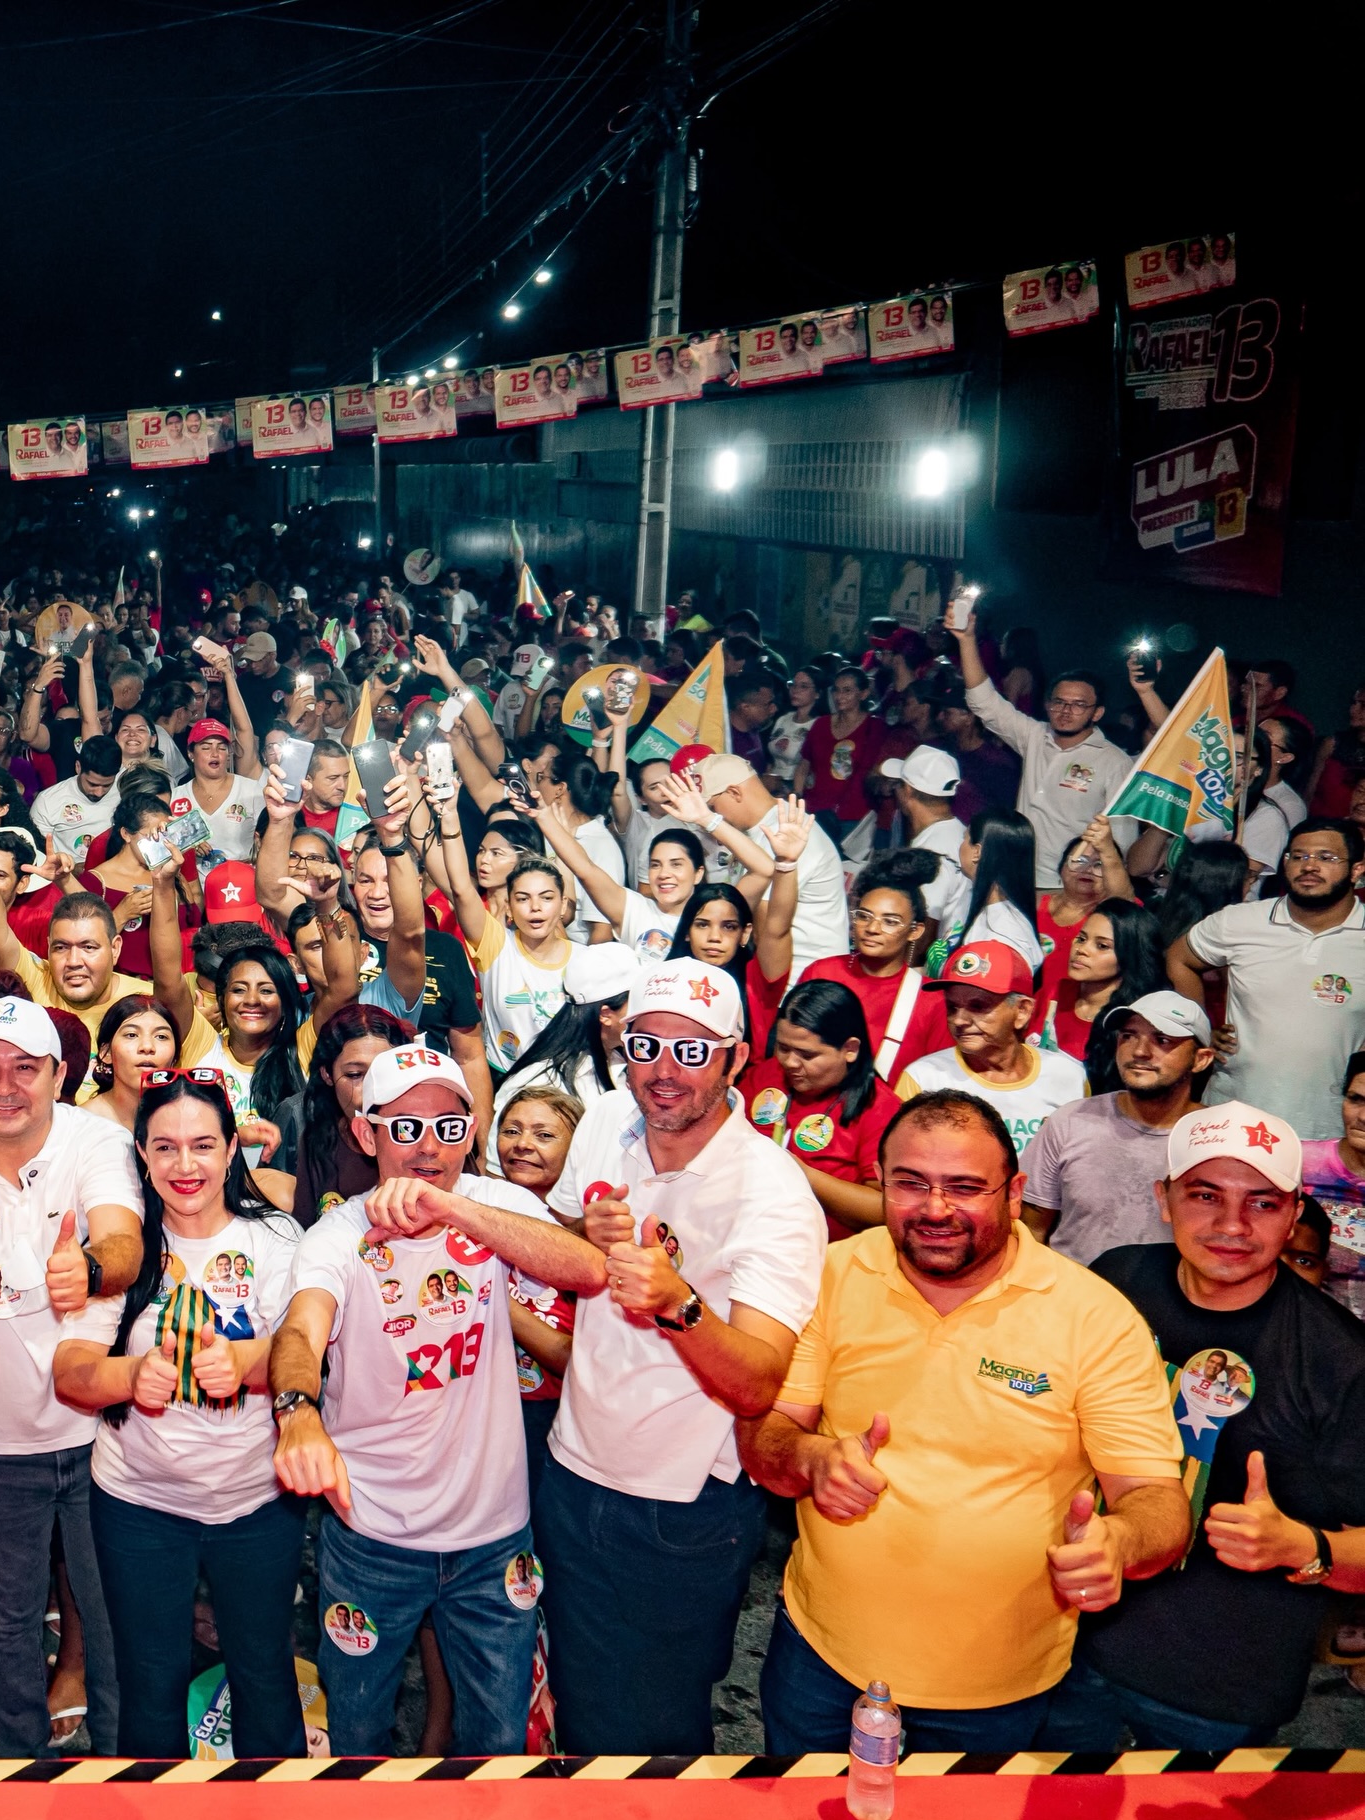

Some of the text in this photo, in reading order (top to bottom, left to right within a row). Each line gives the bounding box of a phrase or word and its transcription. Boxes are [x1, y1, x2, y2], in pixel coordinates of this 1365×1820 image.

[1139, 252, 1161, 274] 13
[1020, 279, 1041, 300] 13
[1133, 273, 1171, 290] RAFAEL
[883, 306, 904, 327] 13
[1014, 301, 1048, 316] RAFAEL
[1151, 316, 1212, 333] GOVERNADOR
[755, 331, 775, 351] 13
[876, 329, 912, 342] RAFAEL
[1126, 323, 1217, 376] RAFAEL
[1212, 298, 1281, 402] 13
[631, 353, 652, 373] 13
[747, 352, 784, 367] RAFAEL
[510, 372, 530, 392] 13
[625, 376, 661, 389] RAFAEL
[347, 389, 363, 405] 13
[389, 390, 408, 409] 13
[503, 395, 539, 407] RAFAEL
[265, 405, 285, 424] 13
[340, 407, 371, 418] RAFAEL
[383, 411, 417, 423] RAFAEL
[141, 417, 161, 435] 13
[258, 426, 294, 438] RAFAEL
[21, 428, 41, 447] 13
[136, 438, 170, 450] RAFAEL
[16, 449, 50, 460] RAFAEL
[1135, 438, 1240, 505] LULA
[643, 736, 667, 756] Pela
[1138, 781, 1166, 798] Pela
[646, 973, 680, 988] Rafael
[698, 984, 714, 1000] 13
[1334, 994, 1345, 1004] 13
[634, 1038, 652, 1060] R
[678, 1043, 704, 1063] 13
[395, 1049, 441, 1070] R13
[152, 1071, 169, 1083] R
[192, 1069, 215, 1081] 13
[397, 1121, 415, 1141] R
[441, 1120, 464, 1141] 13
[1190, 1119, 1230, 1138] Rafael
[1254, 1129, 1273, 1146] 13
[211, 1284, 236, 1294] RAFAEL
[235, 1283, 250, 1298] 13
[428, 1305, 452, 1316] RAFAEL
[451, 1299, 467, 1315] 13
[404, 1322, 485, 1397] R13
[979, 1357, 1036, 1382] Magno
[1010, 1379, 1033, 1392] 1013
[1199, 1378, 1212, 1390] 13
[355, 1635, 370, 1649] 13
[195, 1710, 222, 1739] 1013
